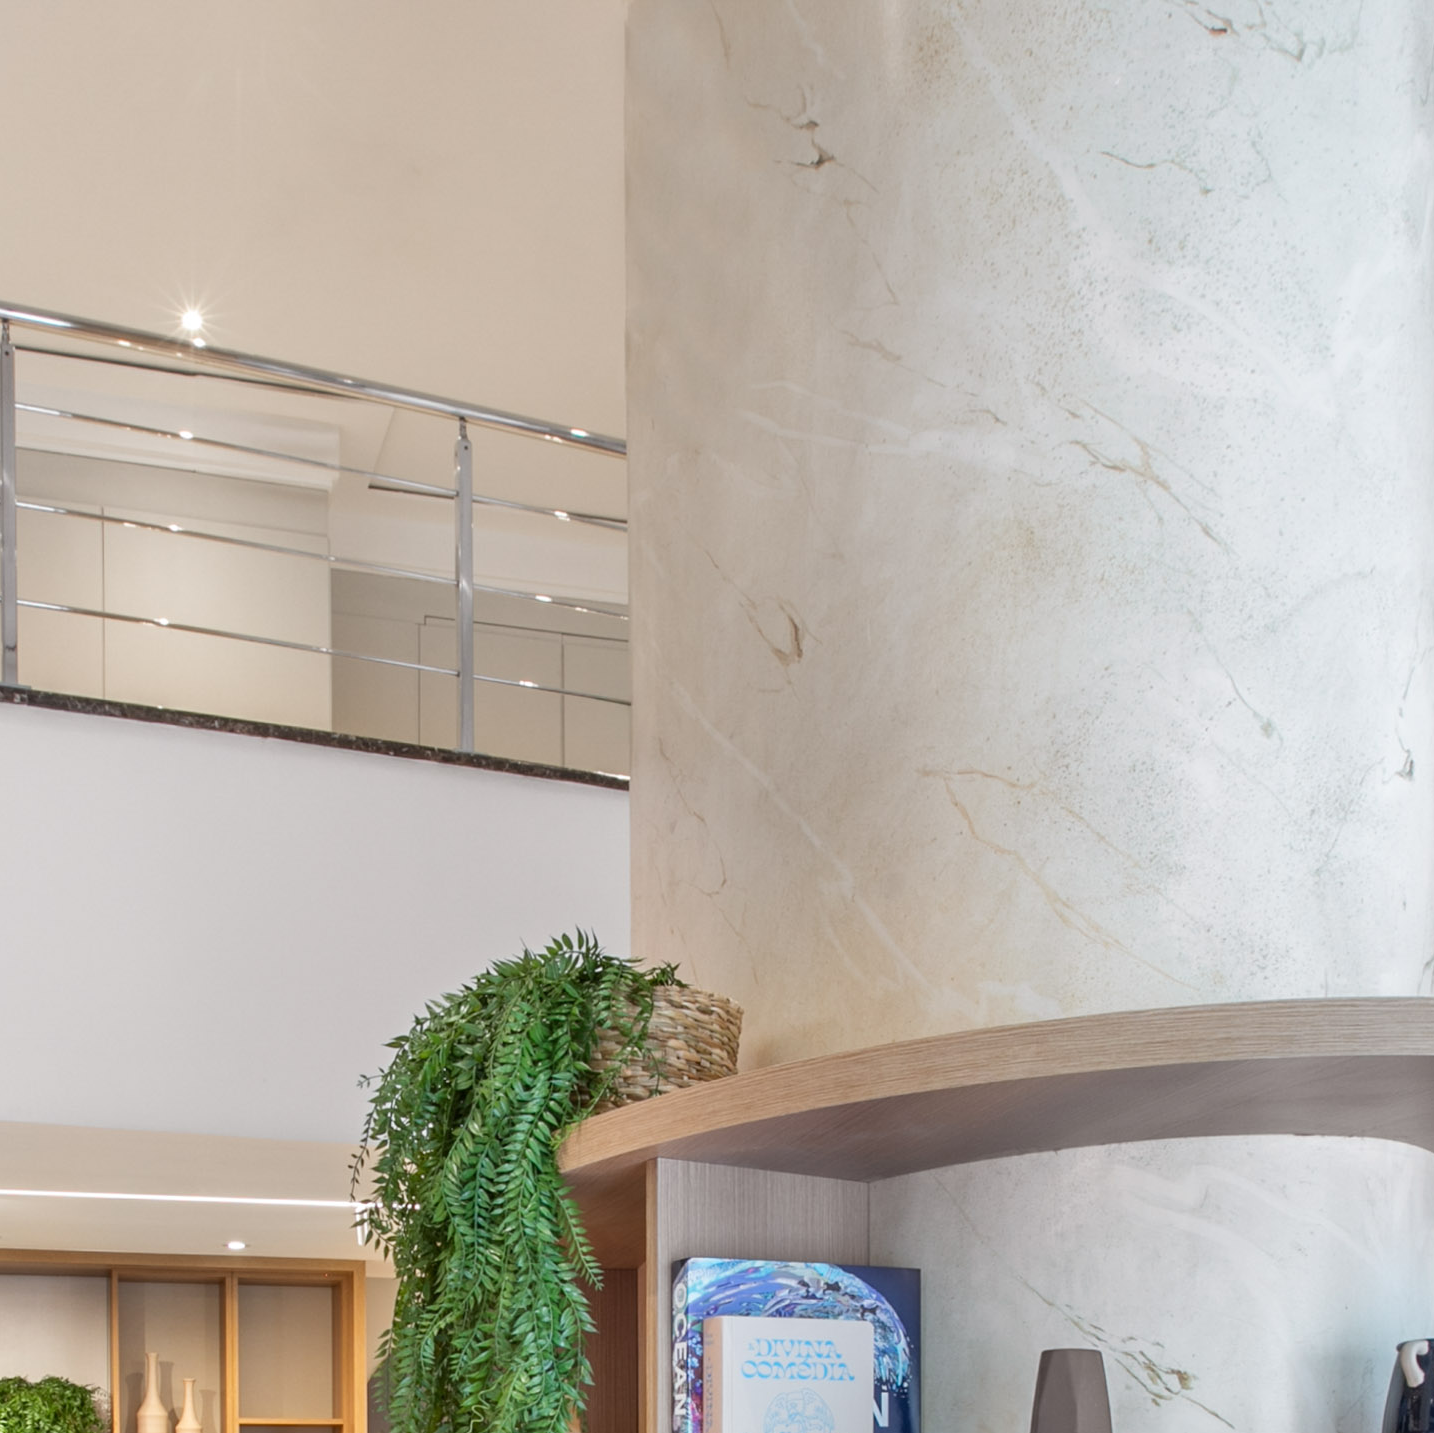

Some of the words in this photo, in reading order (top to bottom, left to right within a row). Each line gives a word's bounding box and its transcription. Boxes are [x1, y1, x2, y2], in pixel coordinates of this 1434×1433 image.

[673, 1283, 688, 1417] OCEAN
[754, 1338, 843, 1359] DIVINA
[740, 1357, 856, 1382] COMÉDIA
